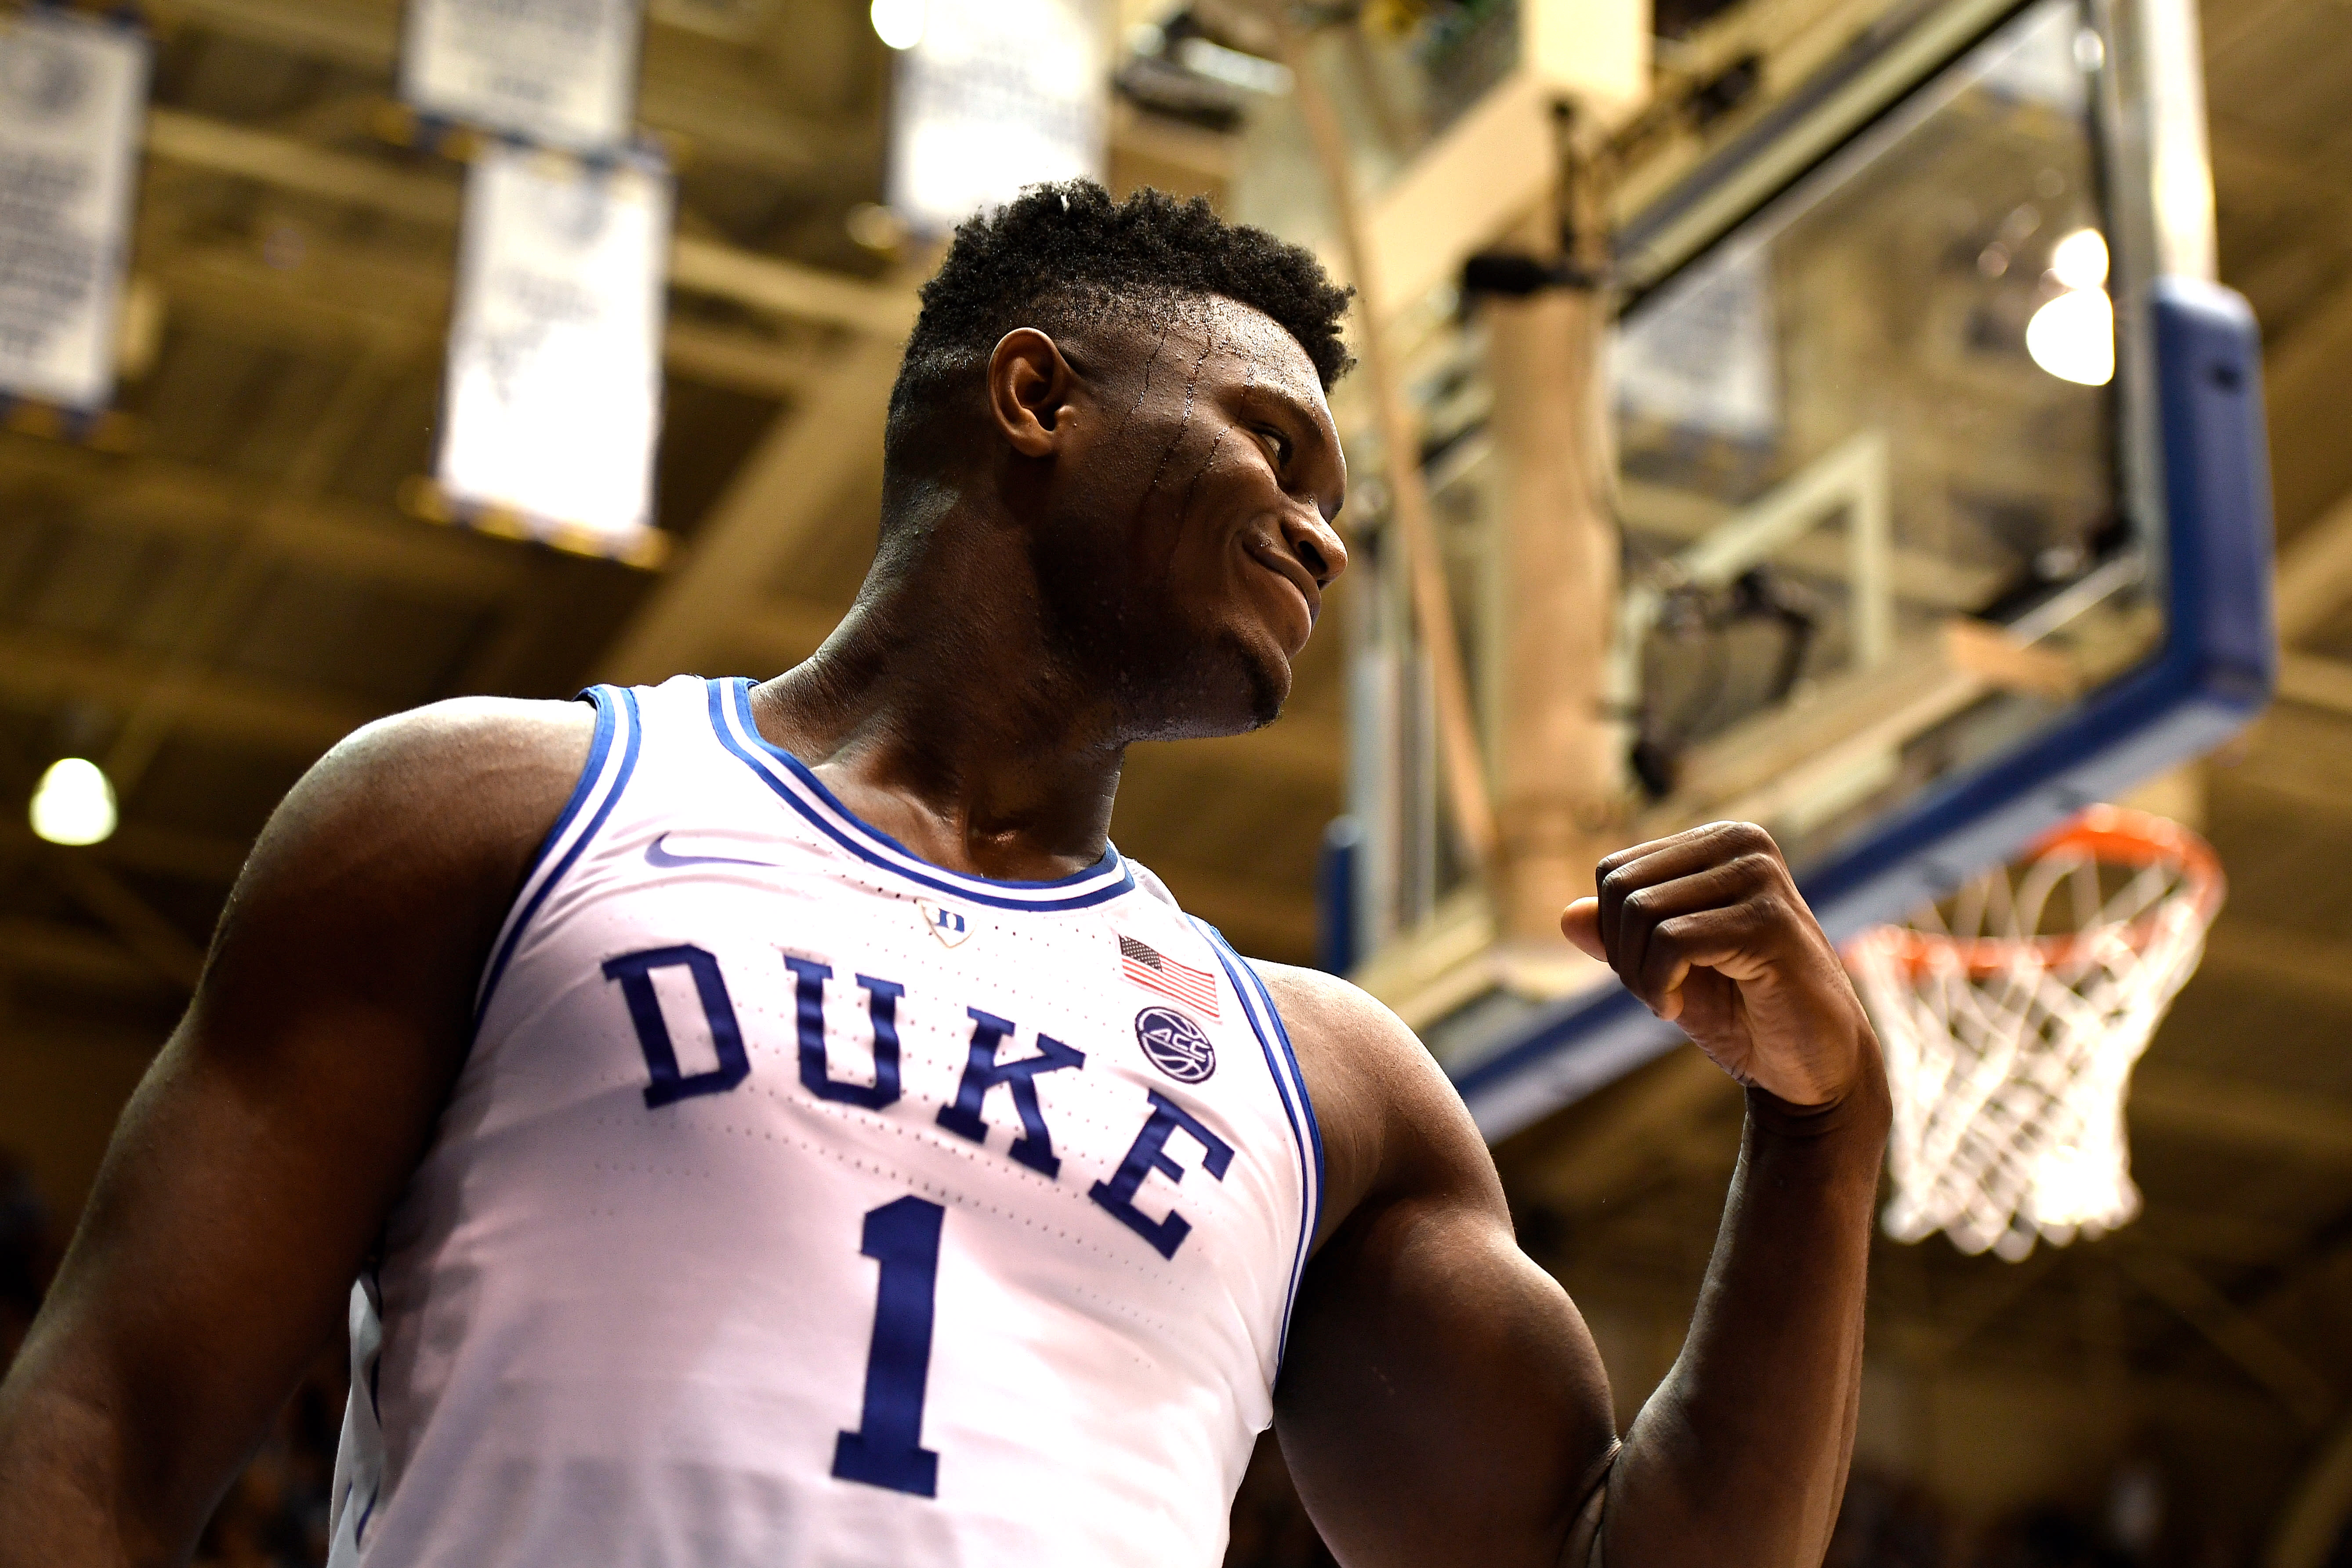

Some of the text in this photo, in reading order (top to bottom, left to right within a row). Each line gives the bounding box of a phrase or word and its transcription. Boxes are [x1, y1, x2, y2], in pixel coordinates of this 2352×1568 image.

[601, 943, 1235, 1261] DUKE
[1142, 1028, 1211, 1063] ACC
[831, 1194, 945, 1501] 1
